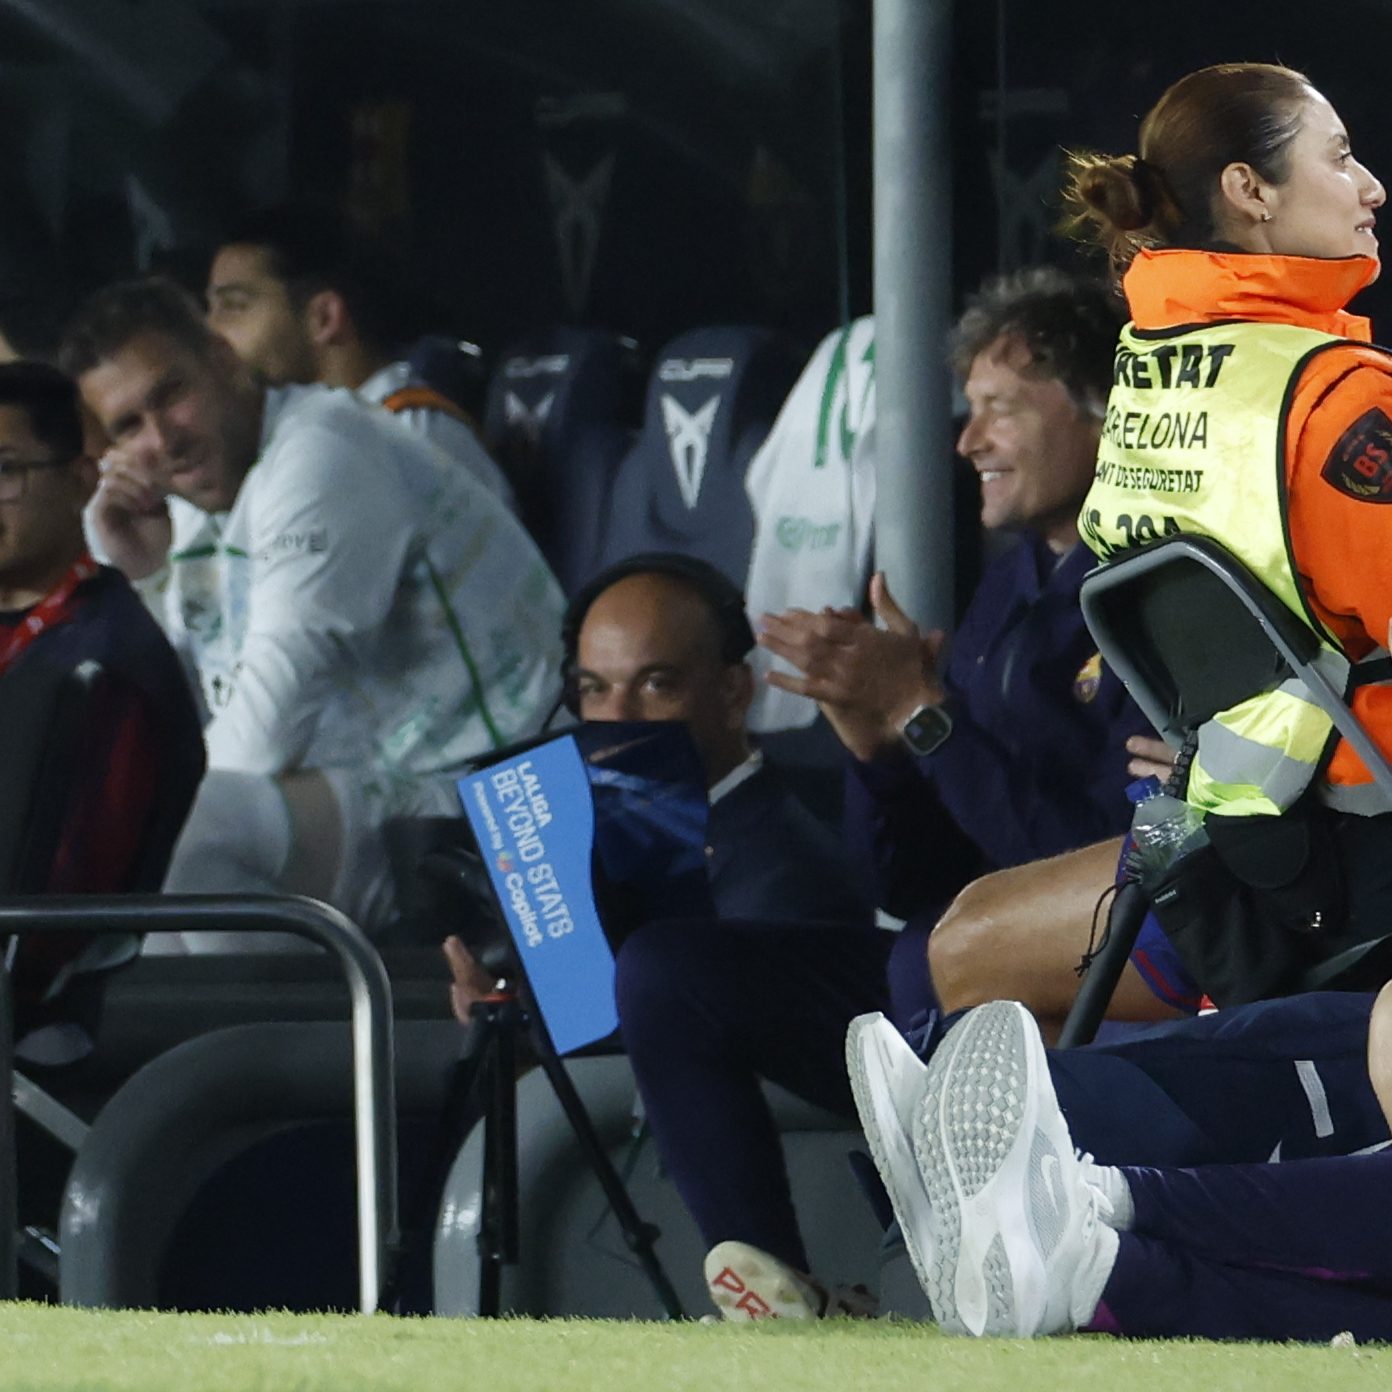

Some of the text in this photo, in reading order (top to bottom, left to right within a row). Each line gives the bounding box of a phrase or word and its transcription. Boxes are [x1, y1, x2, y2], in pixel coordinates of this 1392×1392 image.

[1129, 468, 1204, 493] SEGURETAT
[1353, 442, 1388, 478] BS
[516, 760, 553, 828] LALIGA
[489, 768, 575, 939] BEYOND STATS
[504, 872, 544, 948] Copilot
[712, 1266, 778, 1321] PR
